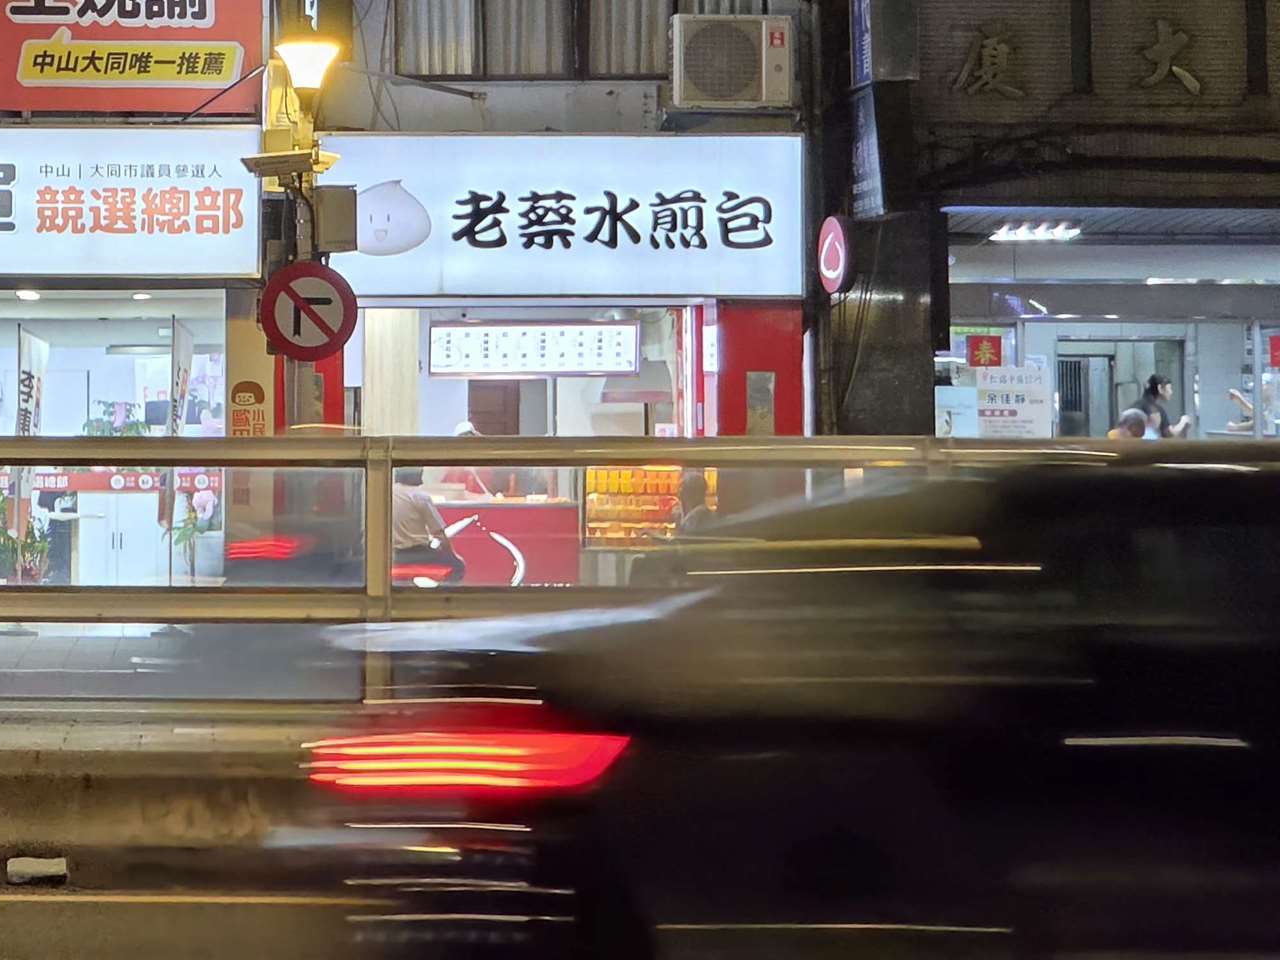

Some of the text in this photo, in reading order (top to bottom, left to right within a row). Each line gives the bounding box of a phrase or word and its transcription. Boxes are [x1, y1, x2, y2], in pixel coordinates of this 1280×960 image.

[32, 49, 225, 76] 中山大同唯一推薦
[36, 185, 244, 234] 競選總部
[452, 189, 774, 250] 老蔡水煎包
[974, 340, 999, 365] 春
